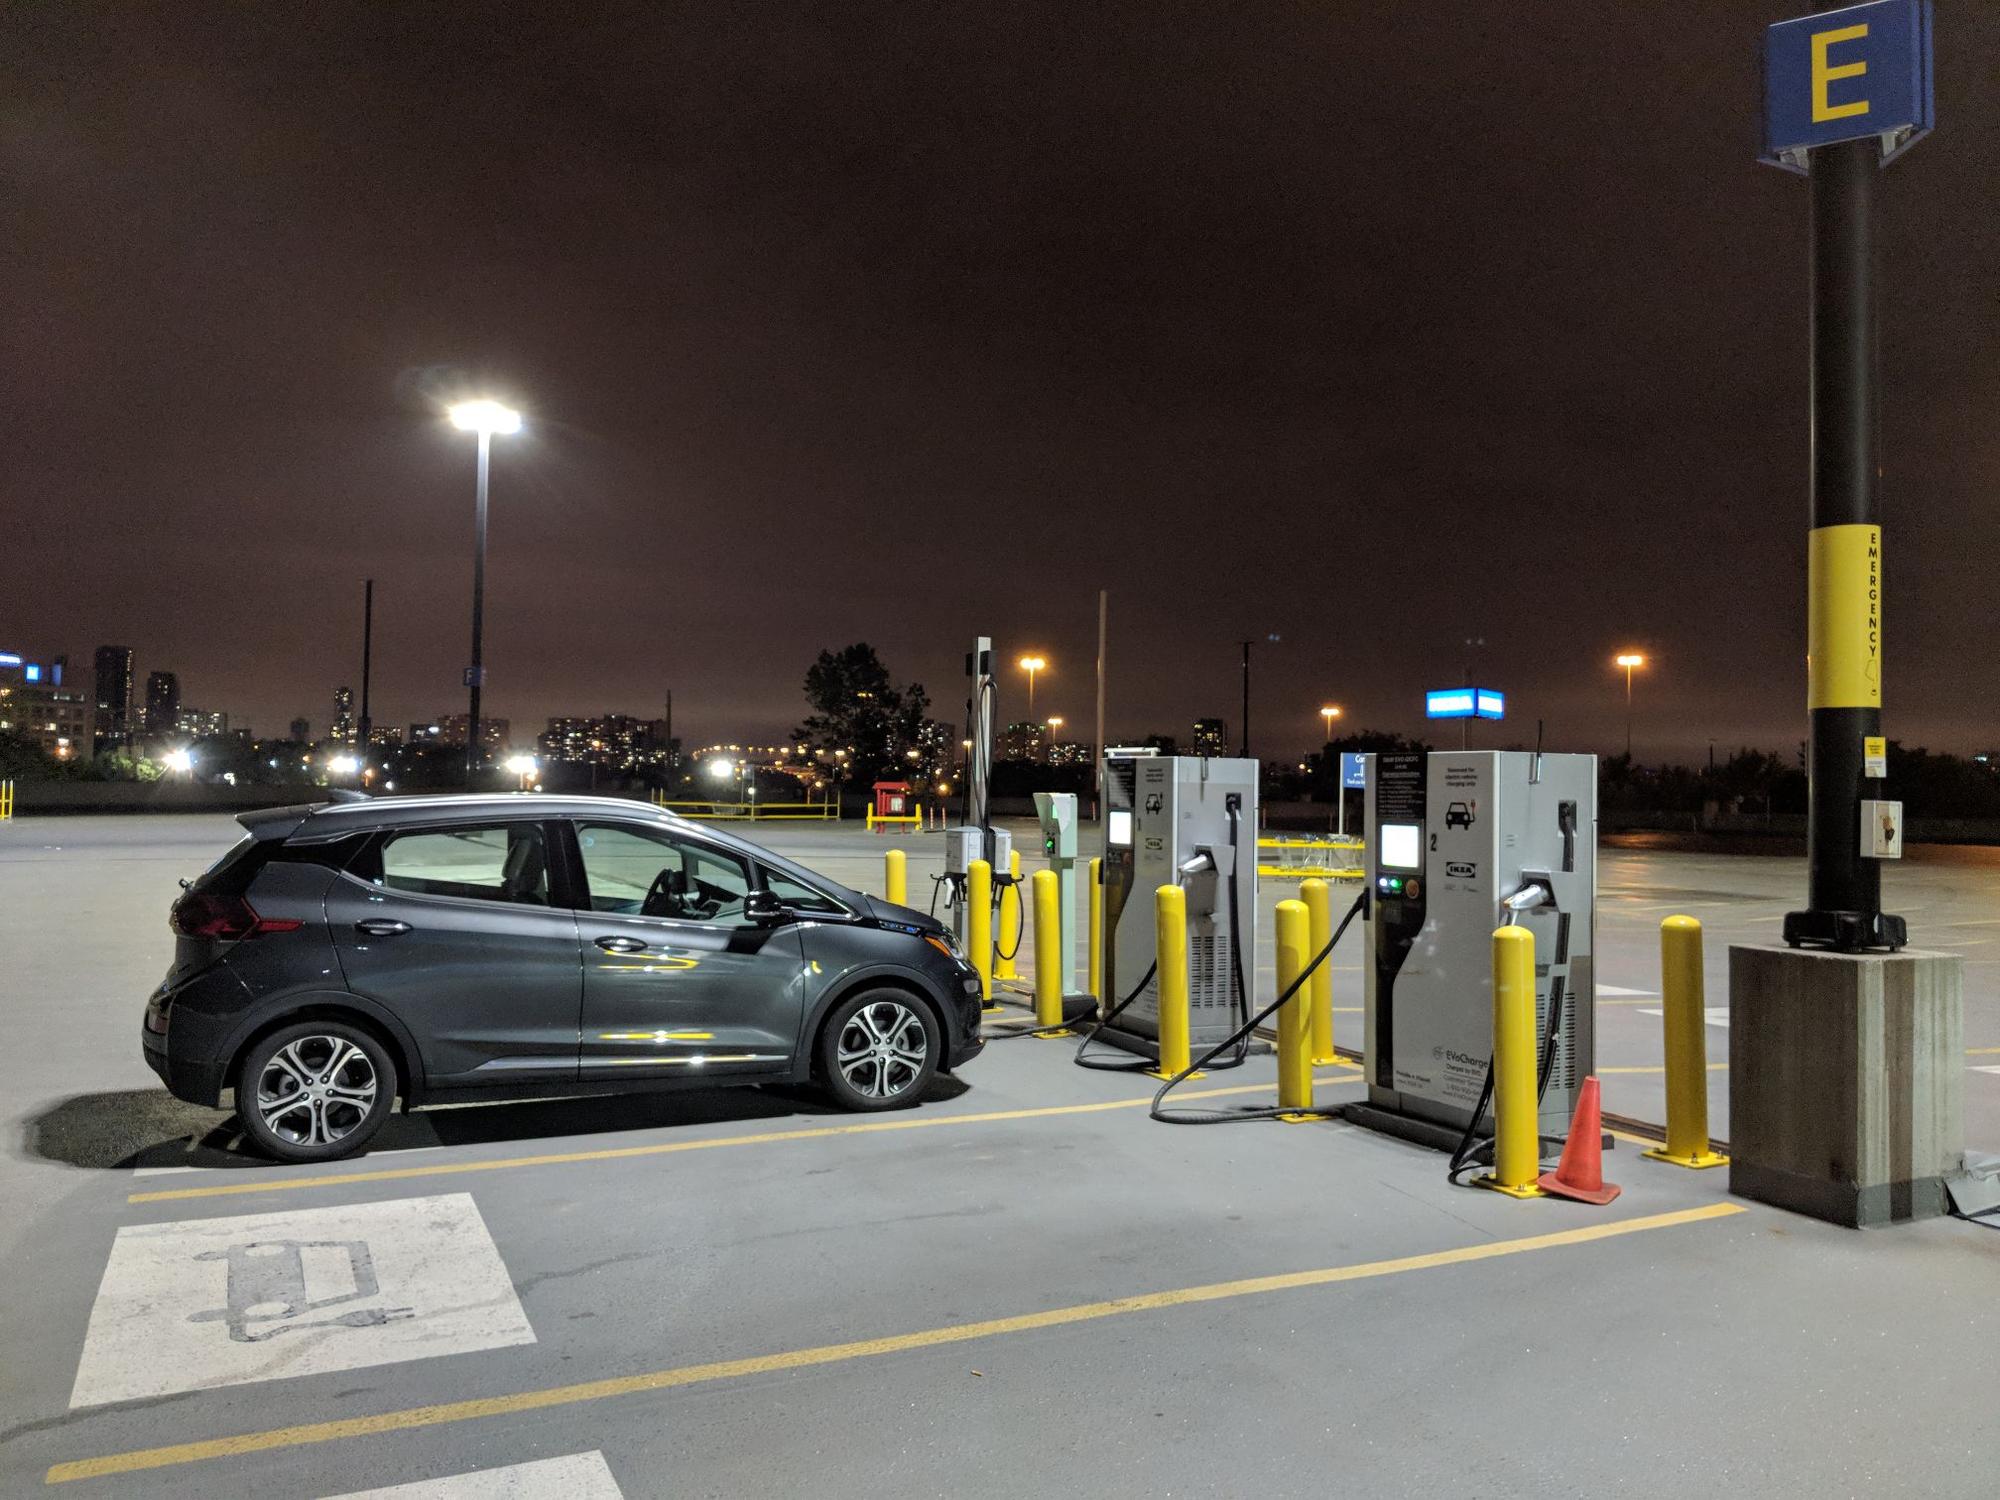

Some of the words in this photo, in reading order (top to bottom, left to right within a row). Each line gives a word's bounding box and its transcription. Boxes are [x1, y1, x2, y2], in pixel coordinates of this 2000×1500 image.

[1811, 23, 1869, 123] E
[1868, 533, 1878, 657] EMERGENCY
[1430, 833, 1437, 851] 2
[1450, 865, 1472, 874] IKEA
